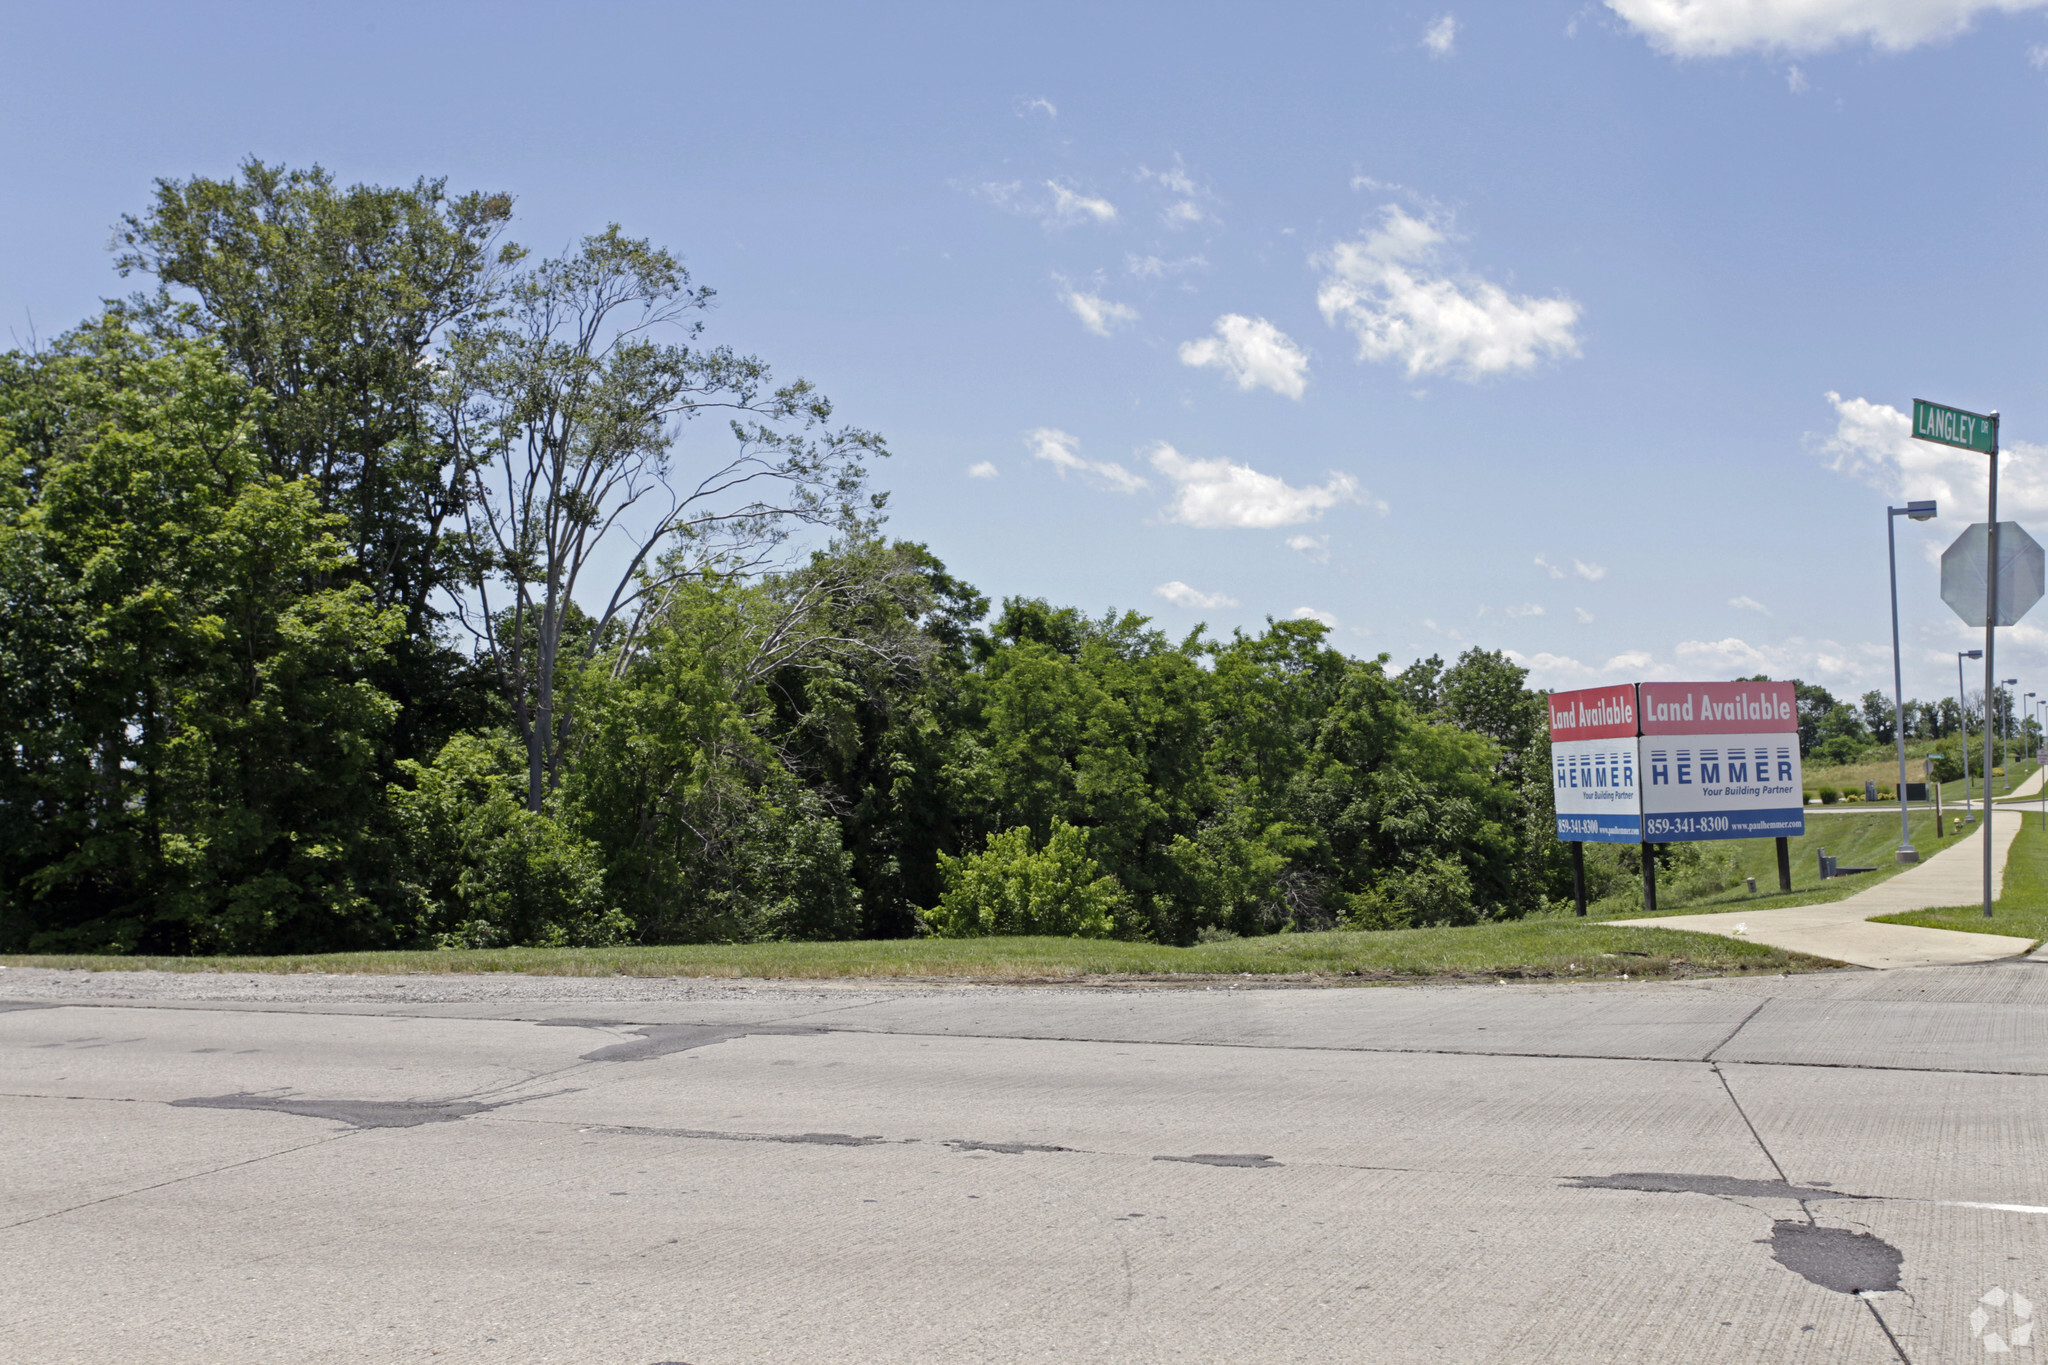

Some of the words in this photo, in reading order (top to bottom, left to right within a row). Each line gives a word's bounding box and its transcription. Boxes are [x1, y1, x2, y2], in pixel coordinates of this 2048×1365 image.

[1919, 405, 1976, 444] LANGLEY
[1981, 420, 1989, 433] DR
[1551, 702, 1576, 730] Land
[1579, 696, 1633, 727] Available
[1646, 694, 1693, 721] Land
[1700, 693, 1790, 720] Available
[1557, 766, 1633, 788] HEMMER
[1652, 761, 1792, 785] HEMMER
[1583, 792, 1593, 800] Your
[1594, 791, 1614, 801] Building
[1615, 792, 1633, 800] Partner
[1703, 787, 1723, 796] Your
[1725, 786, 1760, 796] Building
[1762, 786, 1793, 794] Partner
[1557, 819, 1598, 834] 859-341-8300
[1648, 816, 1728, 835] 859-341-8300
[1731, 820, 1802, 832] www.paulhemmer.com
